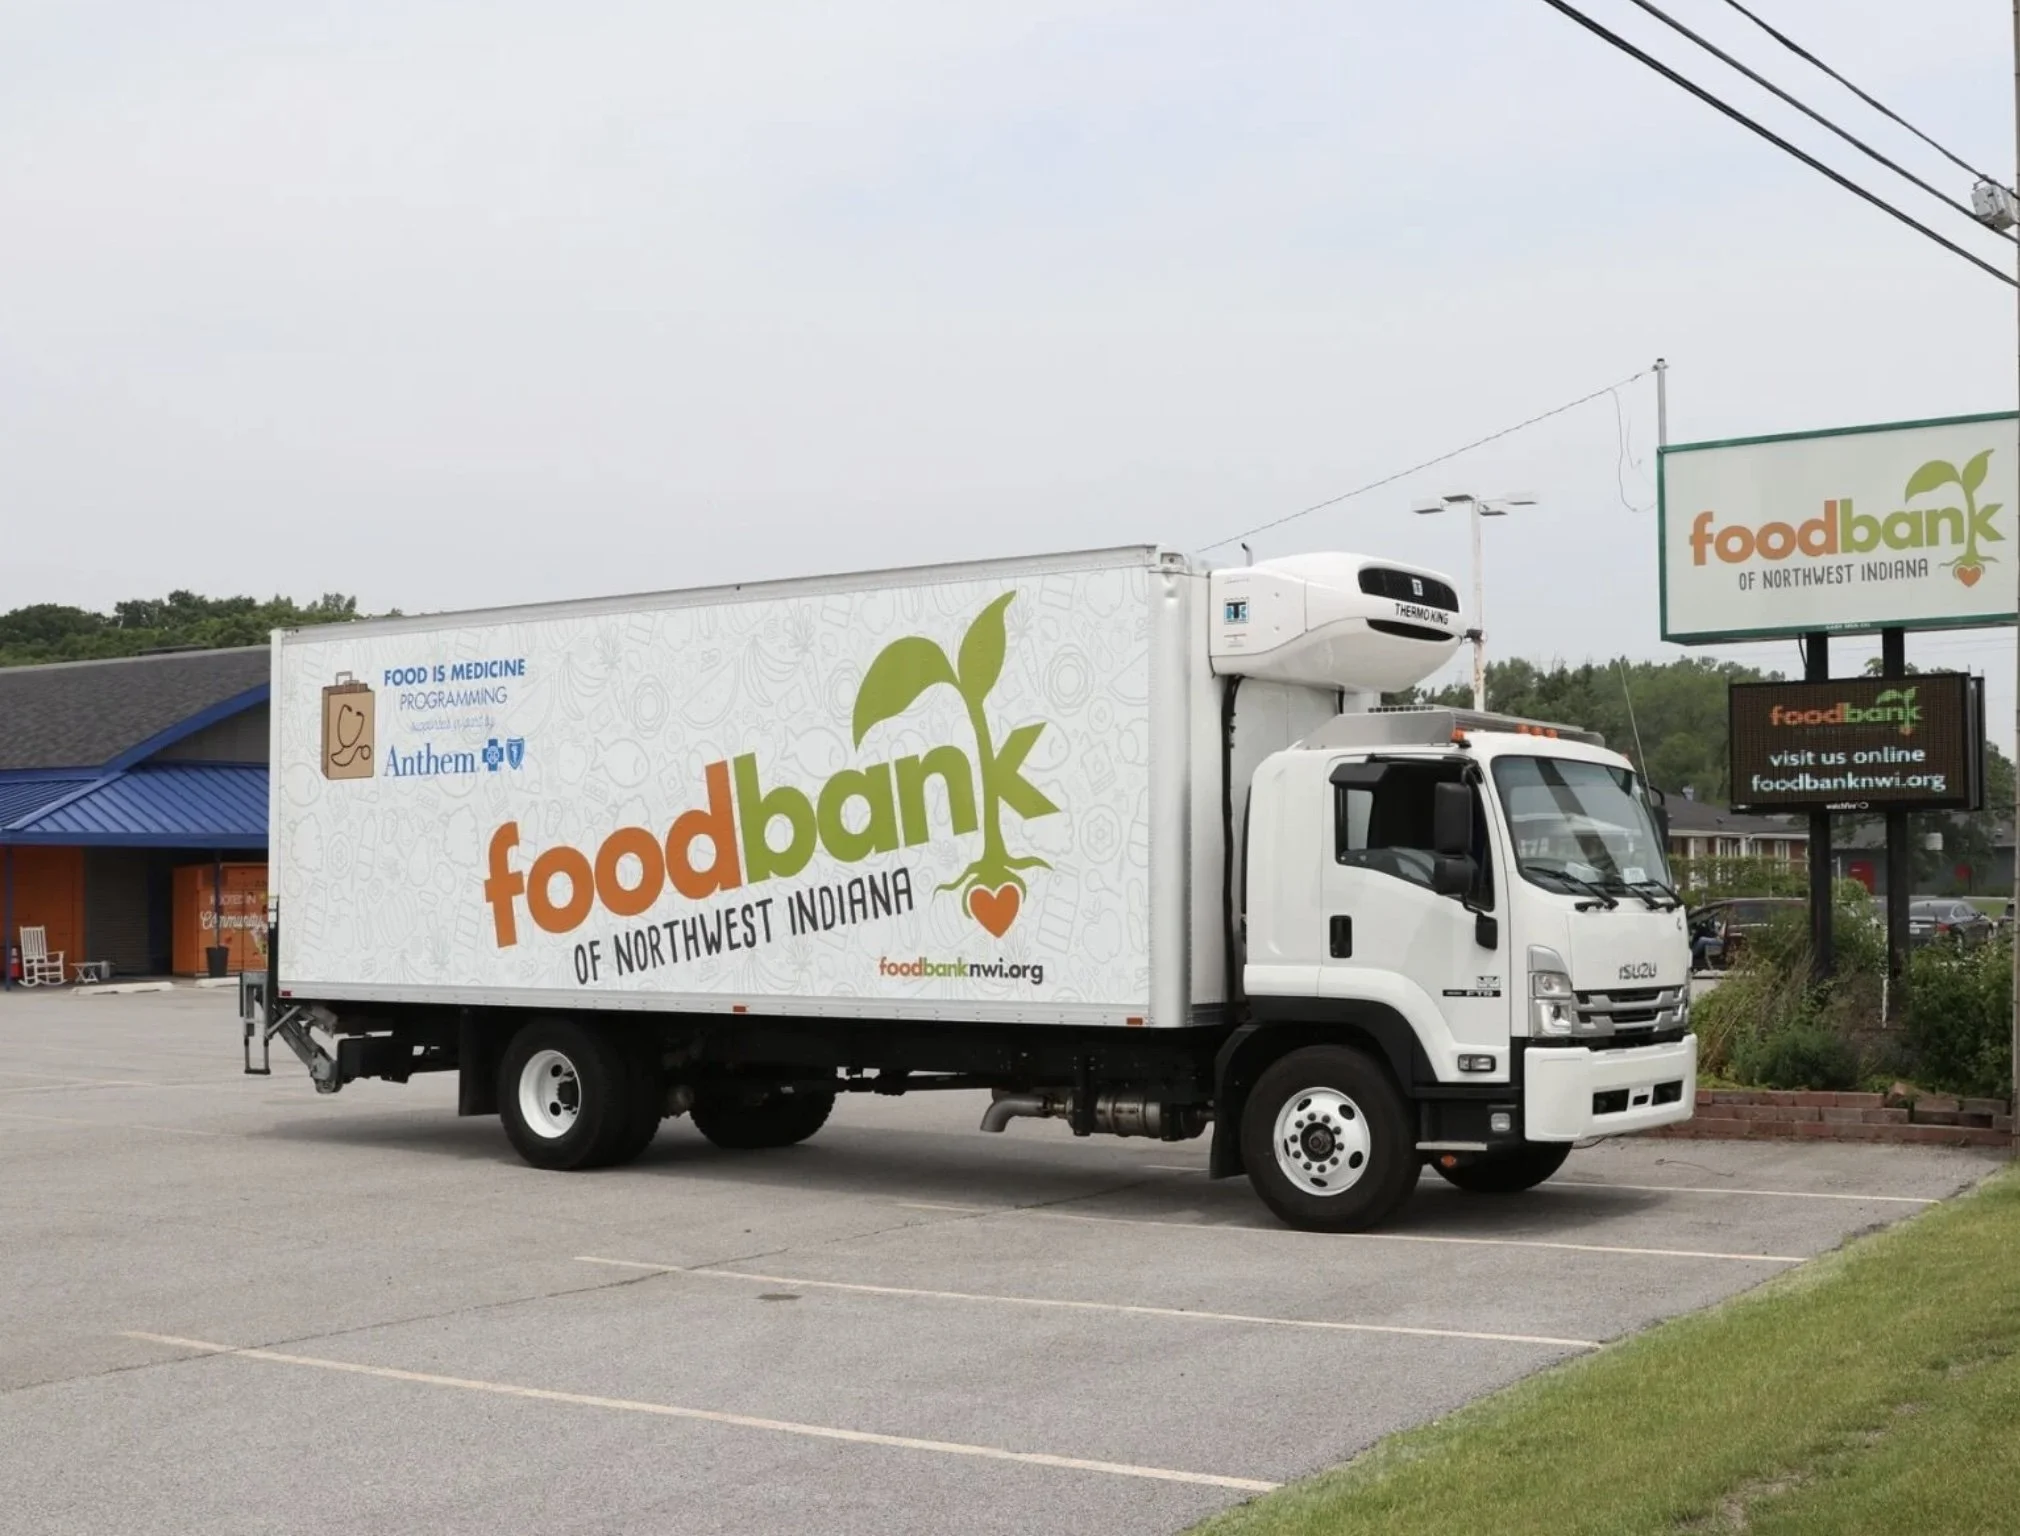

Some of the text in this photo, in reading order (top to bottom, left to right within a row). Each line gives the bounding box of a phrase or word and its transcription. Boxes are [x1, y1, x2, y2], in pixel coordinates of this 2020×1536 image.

[1689, 490, 2006, 566] foodbank
[1738, 557, 1928, 591] OF NORTHWEST INDIANA
[1395, 602, 1449, 626] THERMO KING
[384, 658, 526, 687] FOOD IS MEDICINE
[400, 686, 508, 711] PROGRAMMING
[1769, 699, 1923, 726] foodbank
[384, 742, 476, 777] Anthem
[1769, 746, 1926, 767] visit us online
[1751, 770, 1947, 793] foodbanknwi.org
[484, 708, 1060, 948] foodbank
[573, 866, 915, 985] OF NORTHWEST INDIANA
[879, 956, 1044, 985] foodbanknwi.org
[1618, 962, 1658, 981] ISUZU
